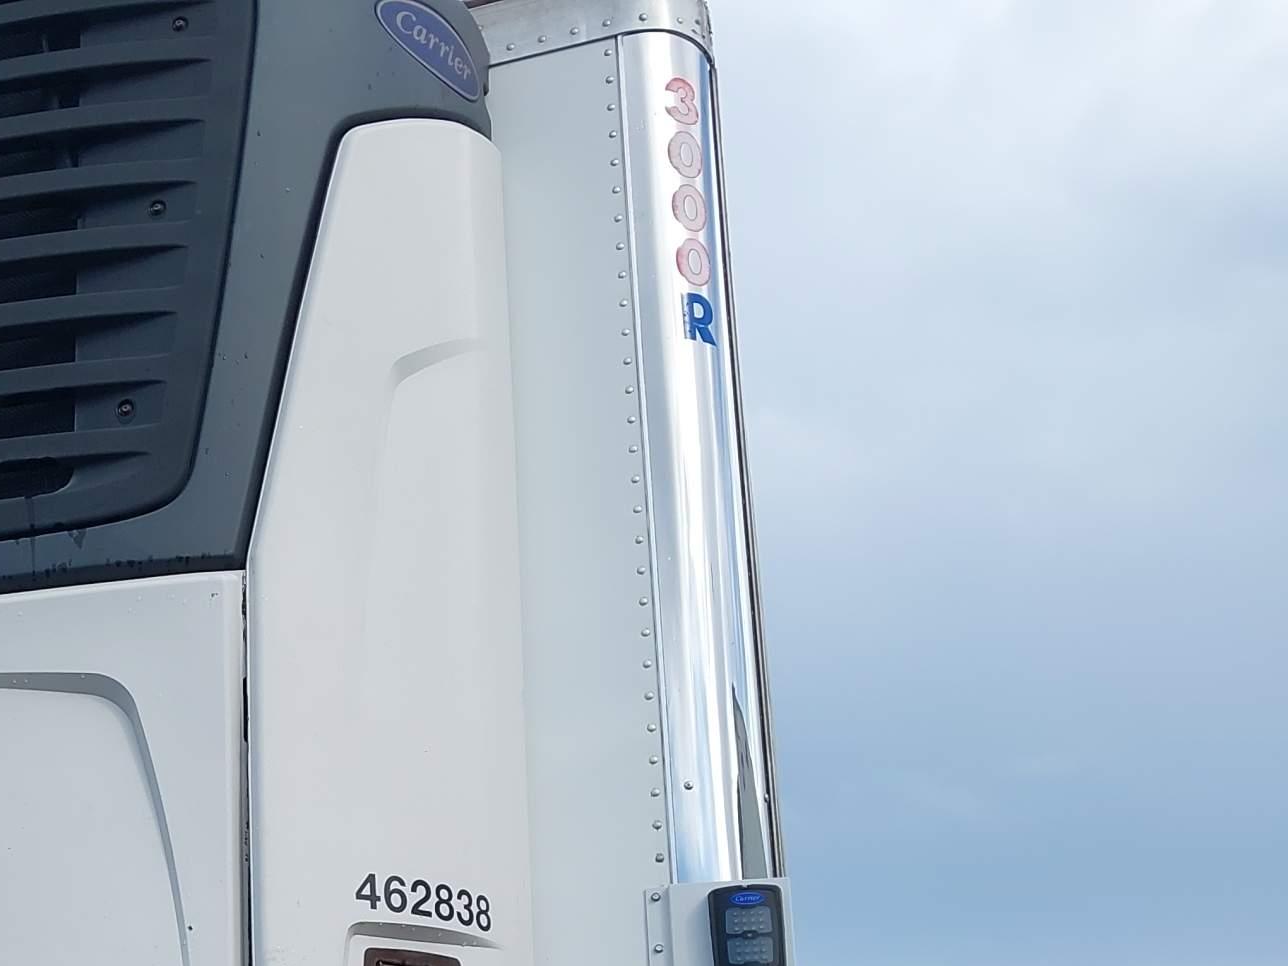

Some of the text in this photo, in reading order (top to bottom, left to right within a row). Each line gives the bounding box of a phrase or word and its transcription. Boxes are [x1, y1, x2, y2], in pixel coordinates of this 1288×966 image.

[396, 11, 472, 81] Carrier
[665, 77, 717, 347] 3000R
[355, 873, 492, 932] 462838
